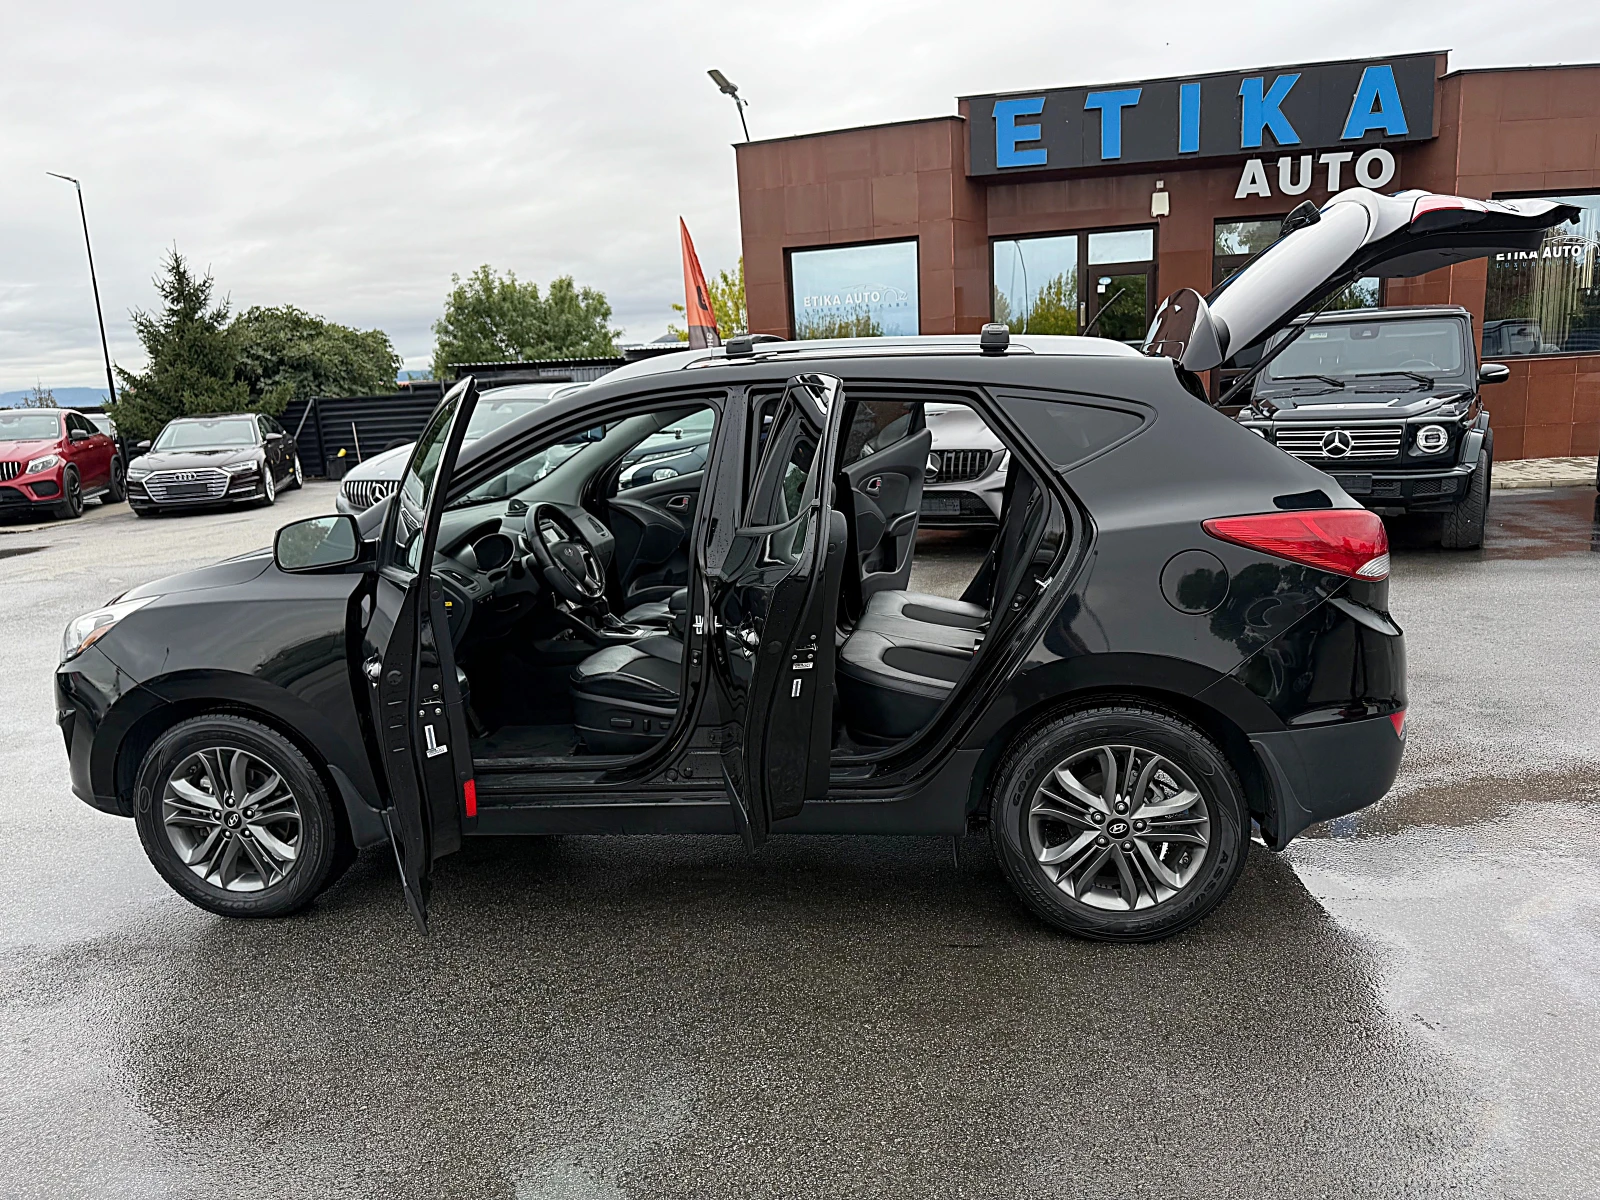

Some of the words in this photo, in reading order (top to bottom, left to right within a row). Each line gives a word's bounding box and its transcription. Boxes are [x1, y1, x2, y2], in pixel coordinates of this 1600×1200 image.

[992, 64, 1409, 168] ETIKA
[1234, 148, 1396, 198] AUTO
[1542, 245, 1581, 258] AUTO
[803, 295, 841, 307] ETIKA
[845, 291, 880, 305] AUTO
